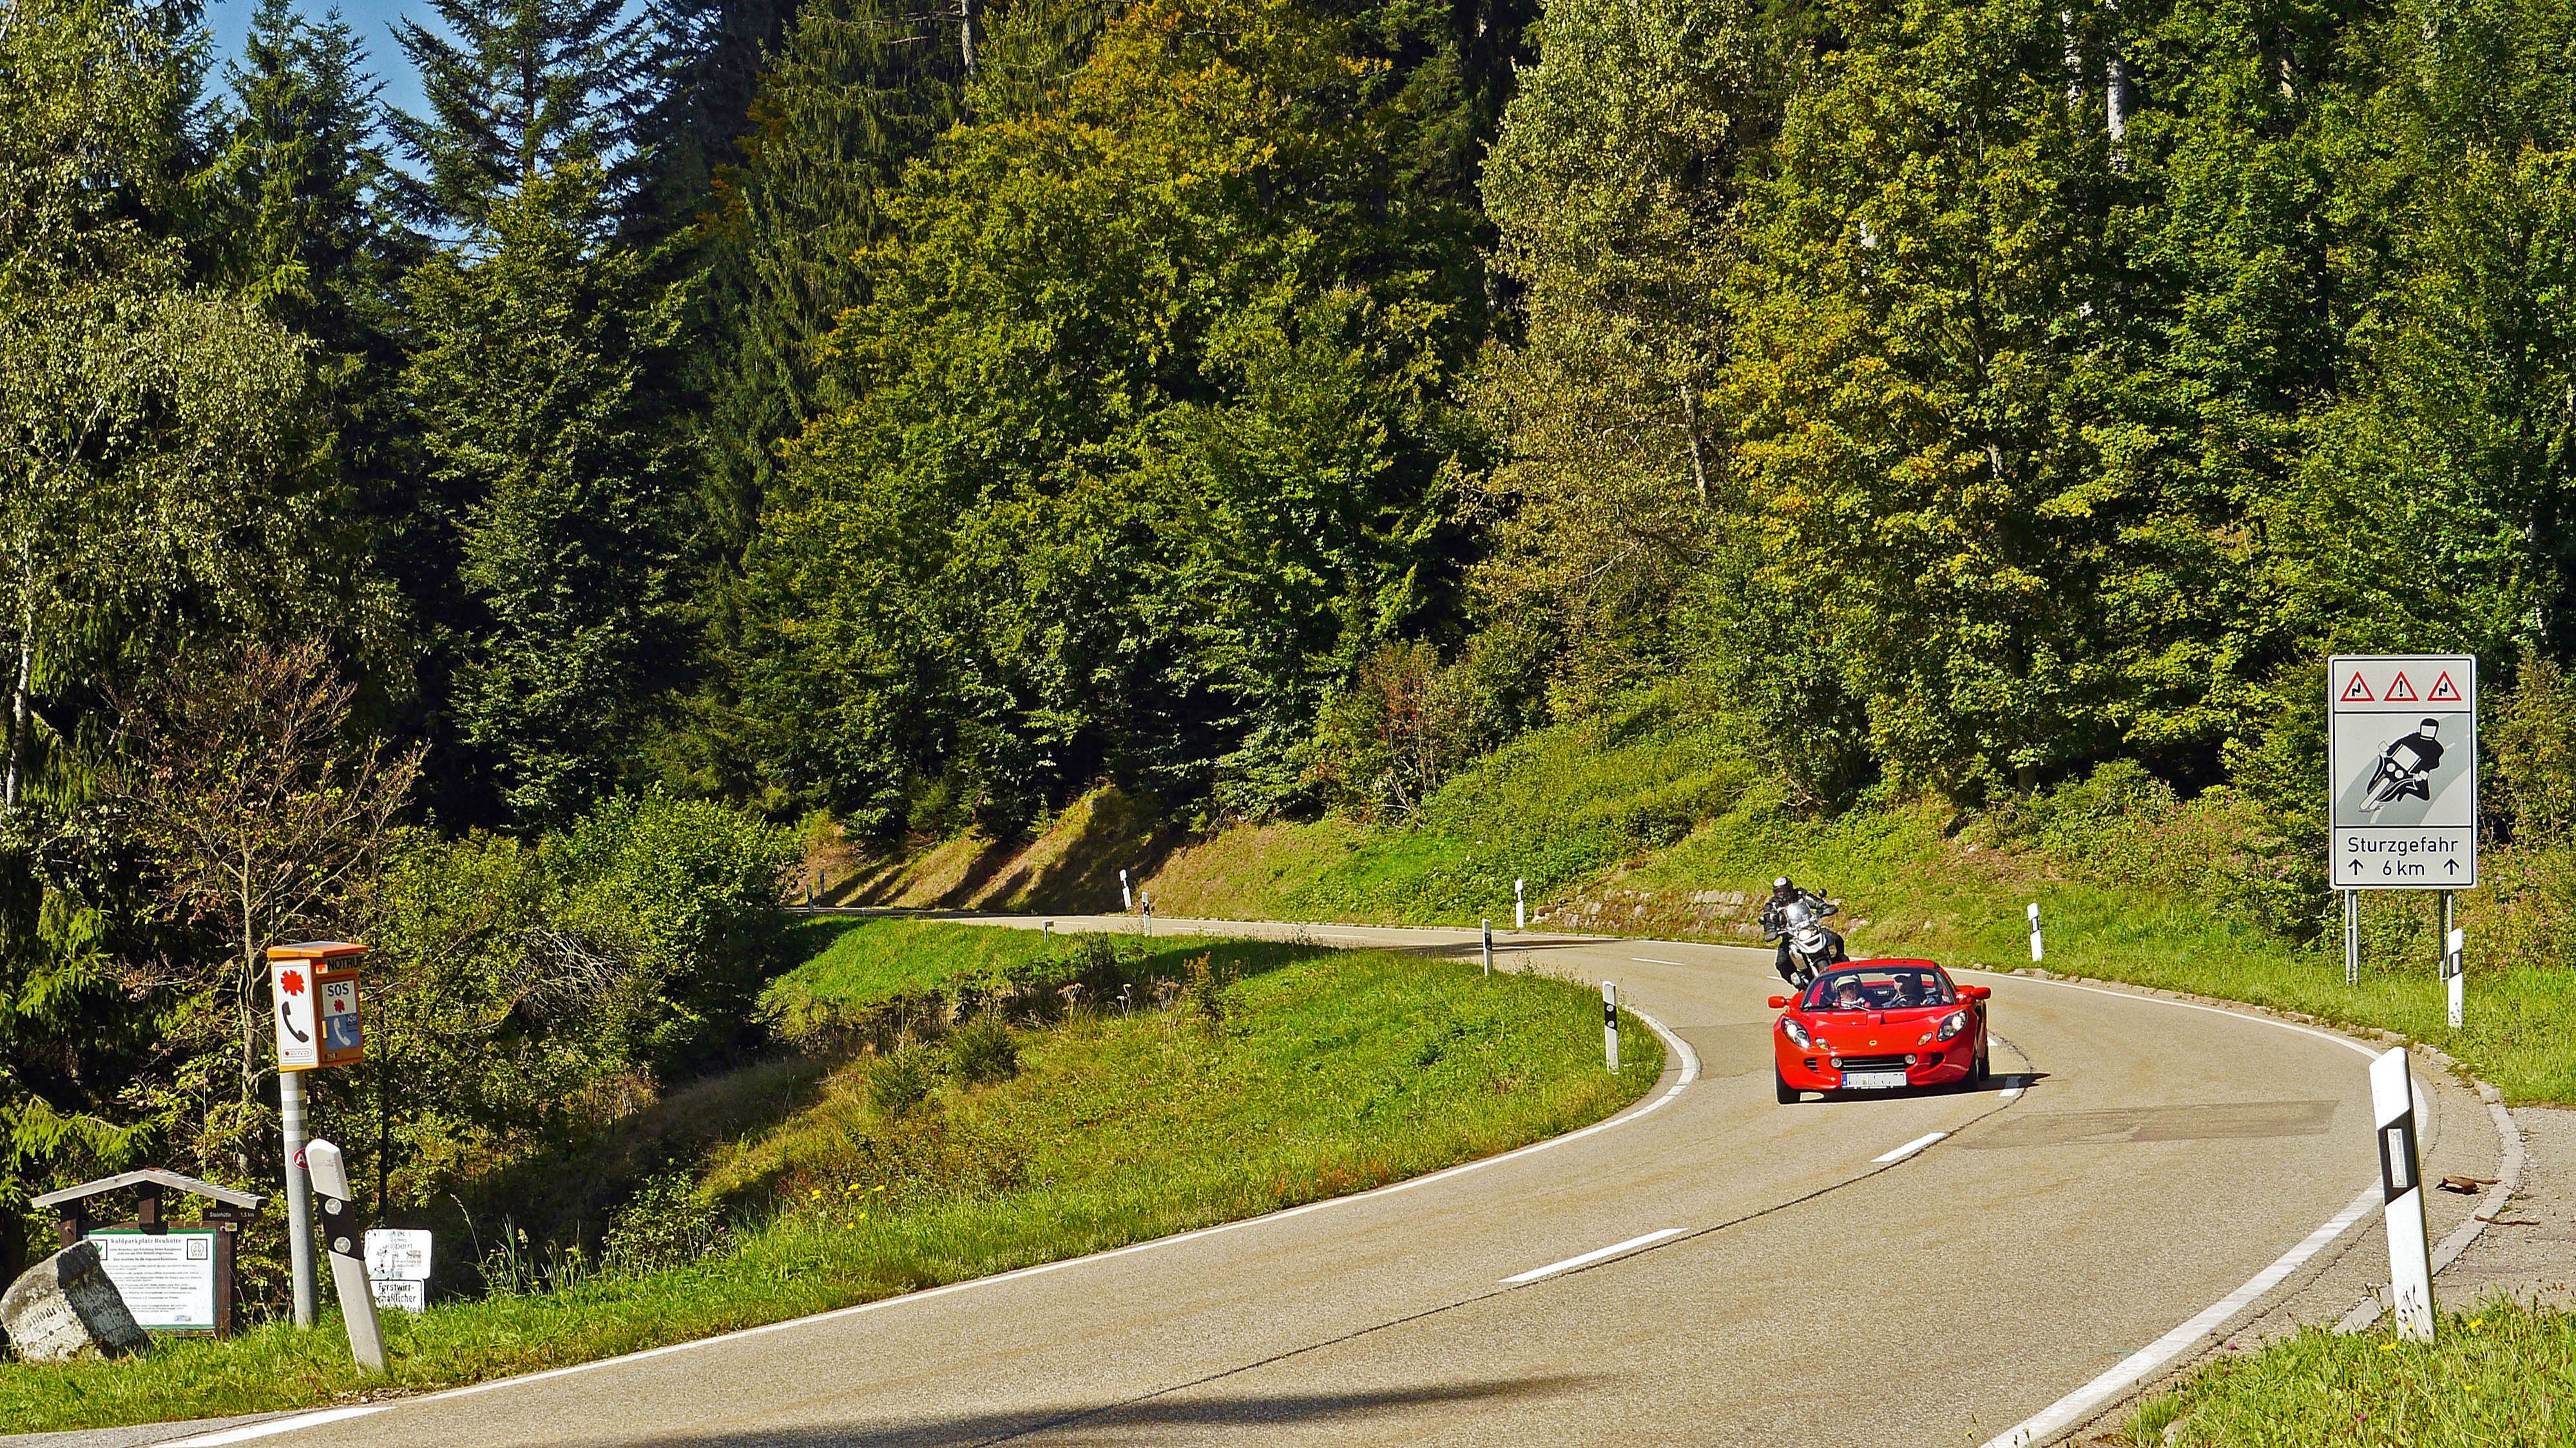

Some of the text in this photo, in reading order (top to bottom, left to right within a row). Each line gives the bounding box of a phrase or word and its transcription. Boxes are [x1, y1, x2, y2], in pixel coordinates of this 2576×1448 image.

[2348, 837, 2459, 856] Sturzgefahr
[2382, 861, 2425, 876] 6 km
[327, 957, 364, 971] NOTRUF
[327, 983, 349, 997] SOS
